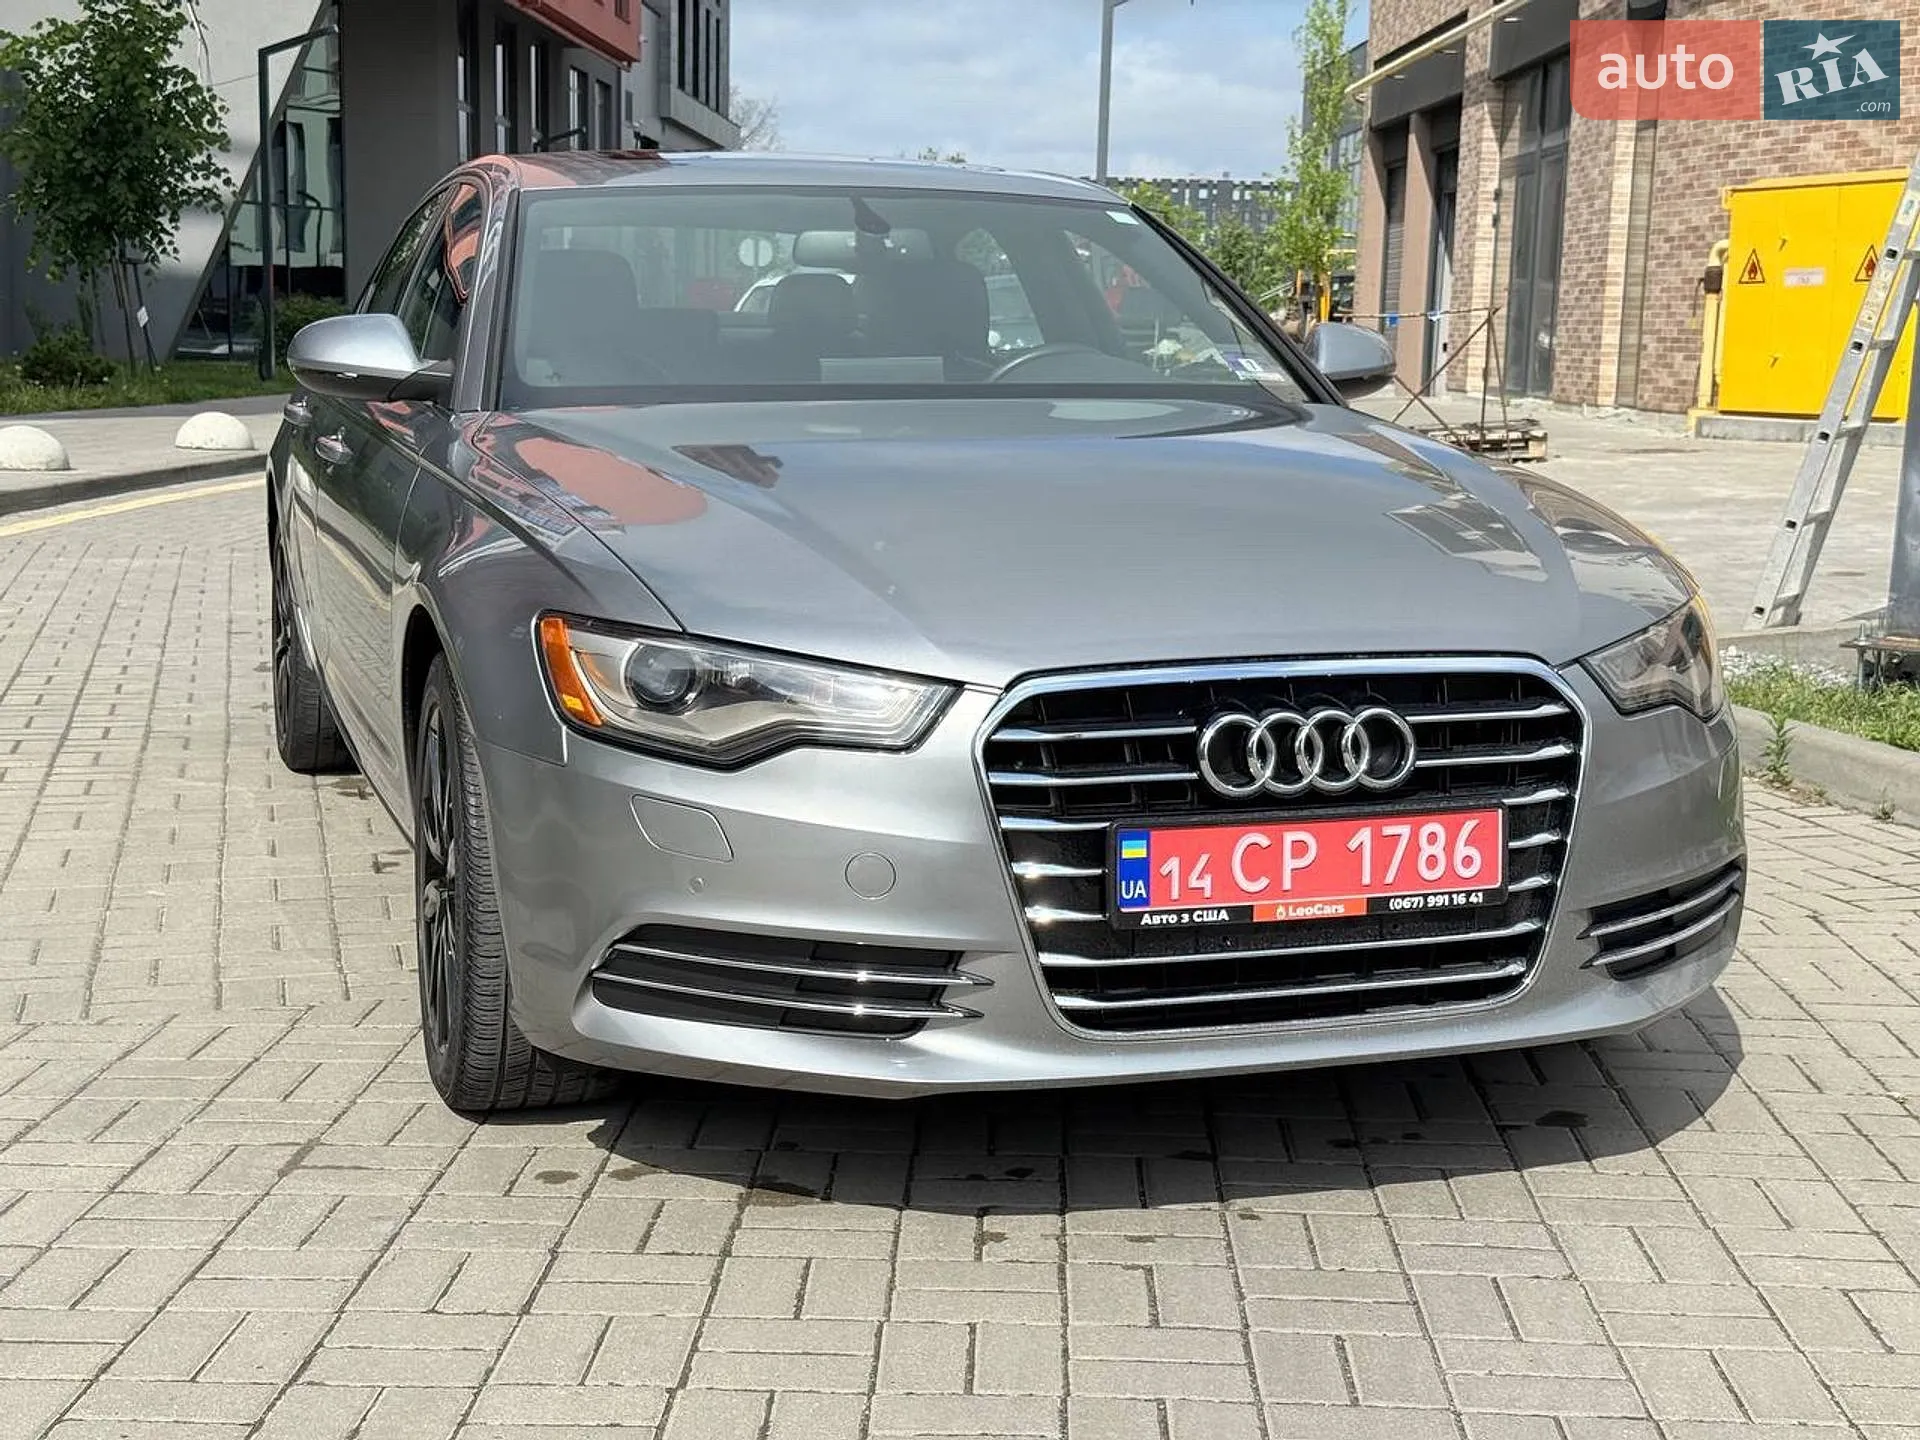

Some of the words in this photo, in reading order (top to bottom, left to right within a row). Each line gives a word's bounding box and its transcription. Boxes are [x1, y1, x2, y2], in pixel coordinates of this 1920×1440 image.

[1160, 853, 1212, 901] 14
[1231, 830, 1318, 893] CP
[1346, 818, 1482, 886] 1786
[1121, 879, 1147, 899] UA
[1288, 903, 1345, 917] LeoCars
[1389, 896, 1424, 910] (067)
[1426, 894, 1449, 907] 991
[1451, 893, 1467, 905] 16
[1468, 891, 1484, 904] 41
[1140, 913, 1178, 926] Авто
[1192, 909, 1230, 923] США
